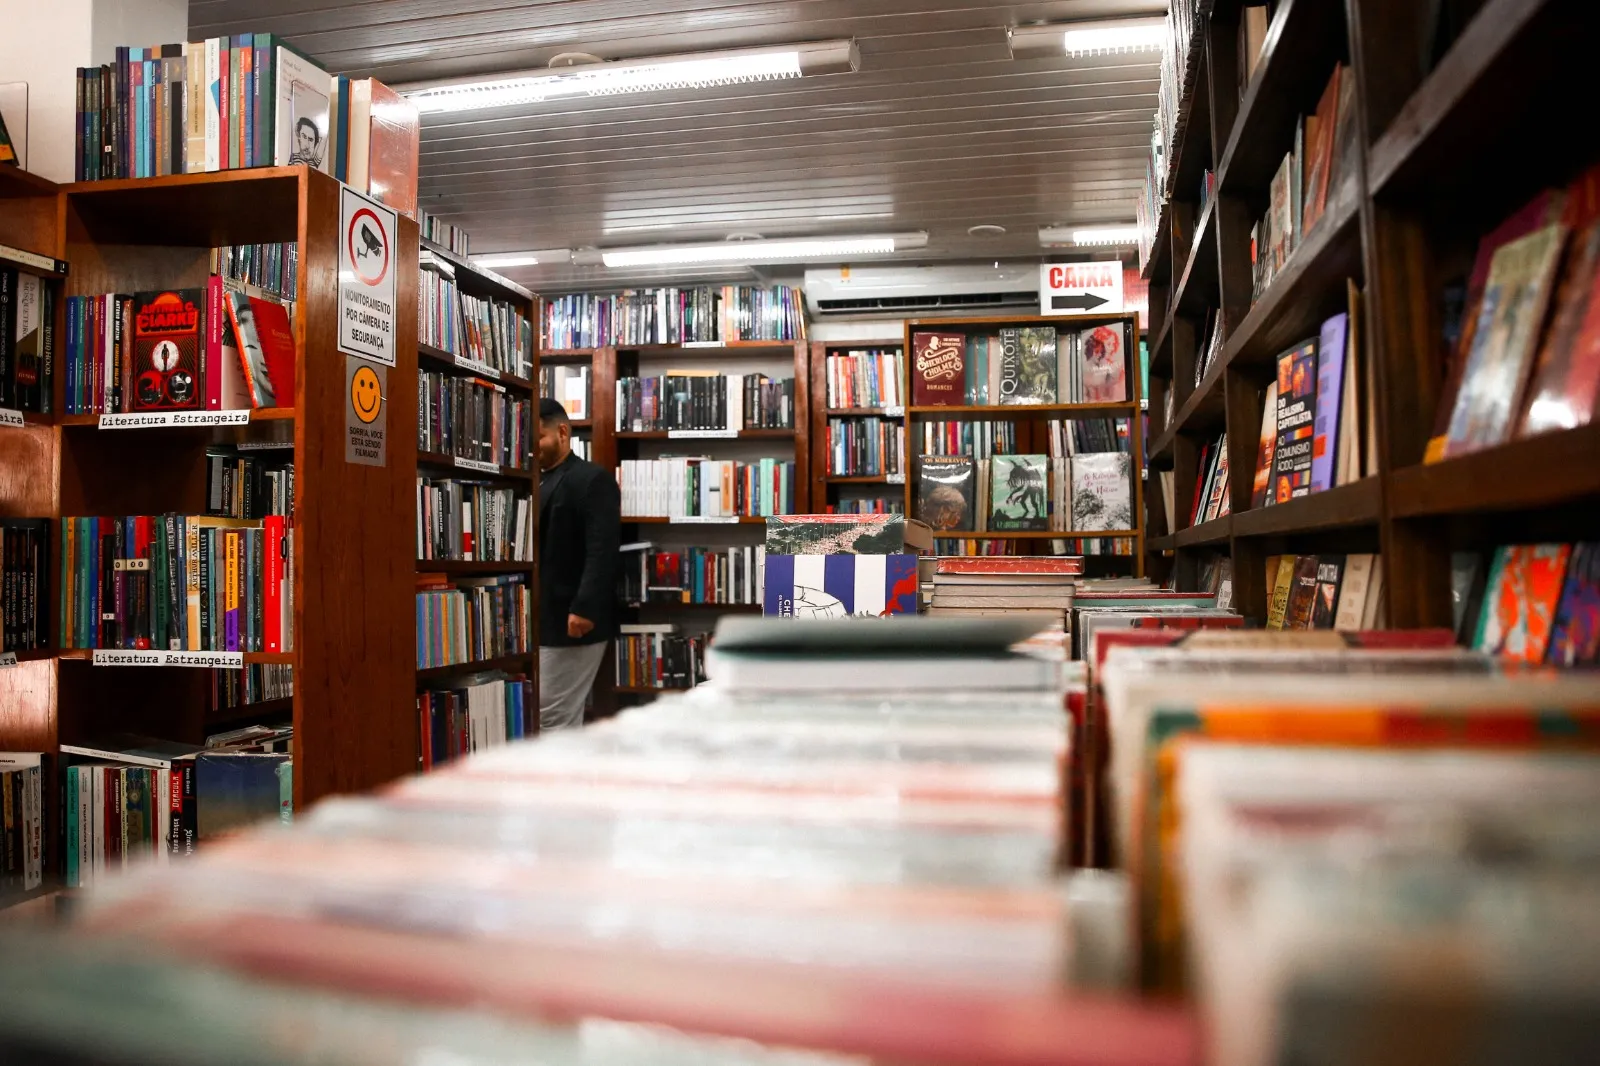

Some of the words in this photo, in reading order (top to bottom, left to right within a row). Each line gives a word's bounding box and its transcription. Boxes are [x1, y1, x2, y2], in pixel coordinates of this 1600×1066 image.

[1049, 265, 1113, 288] CAIXA
[344, 288, 390, 315] MONITORAMENTO
[138, 311, 196, 328] CLARKE
[346, 307, 358, 320] POR
[358, 310, 380, 329] CÂMERA
[381, 320, 390, 332] DE
[351, 328, 384, 350] SEGURANÇA
[1000, 329, 1018, 394] QUIXOTE
[1278, 398, 1286, 409] DO
[1278, 401, 1305, 419] REALISMO
[101, 414, 166, 427] Literatura
[173, 412, 248, 427] Estrangeira
[1278, 410, 1312, 430] CAPITALISTA
[351, 437, 364, 446] ESTÁ
[365, 439, 381, 448] SENDO
[370, 428, 383, 440] VOCÊ
[1278, 435, 1285, 446] AO
[1278, 442, 1310, 459] COMUNISMO
[1317, 563, 1338, 582] CONTRA
[96, 654, 159, 665] Literatura
[166, 654, 242, 667] Estrangeira
